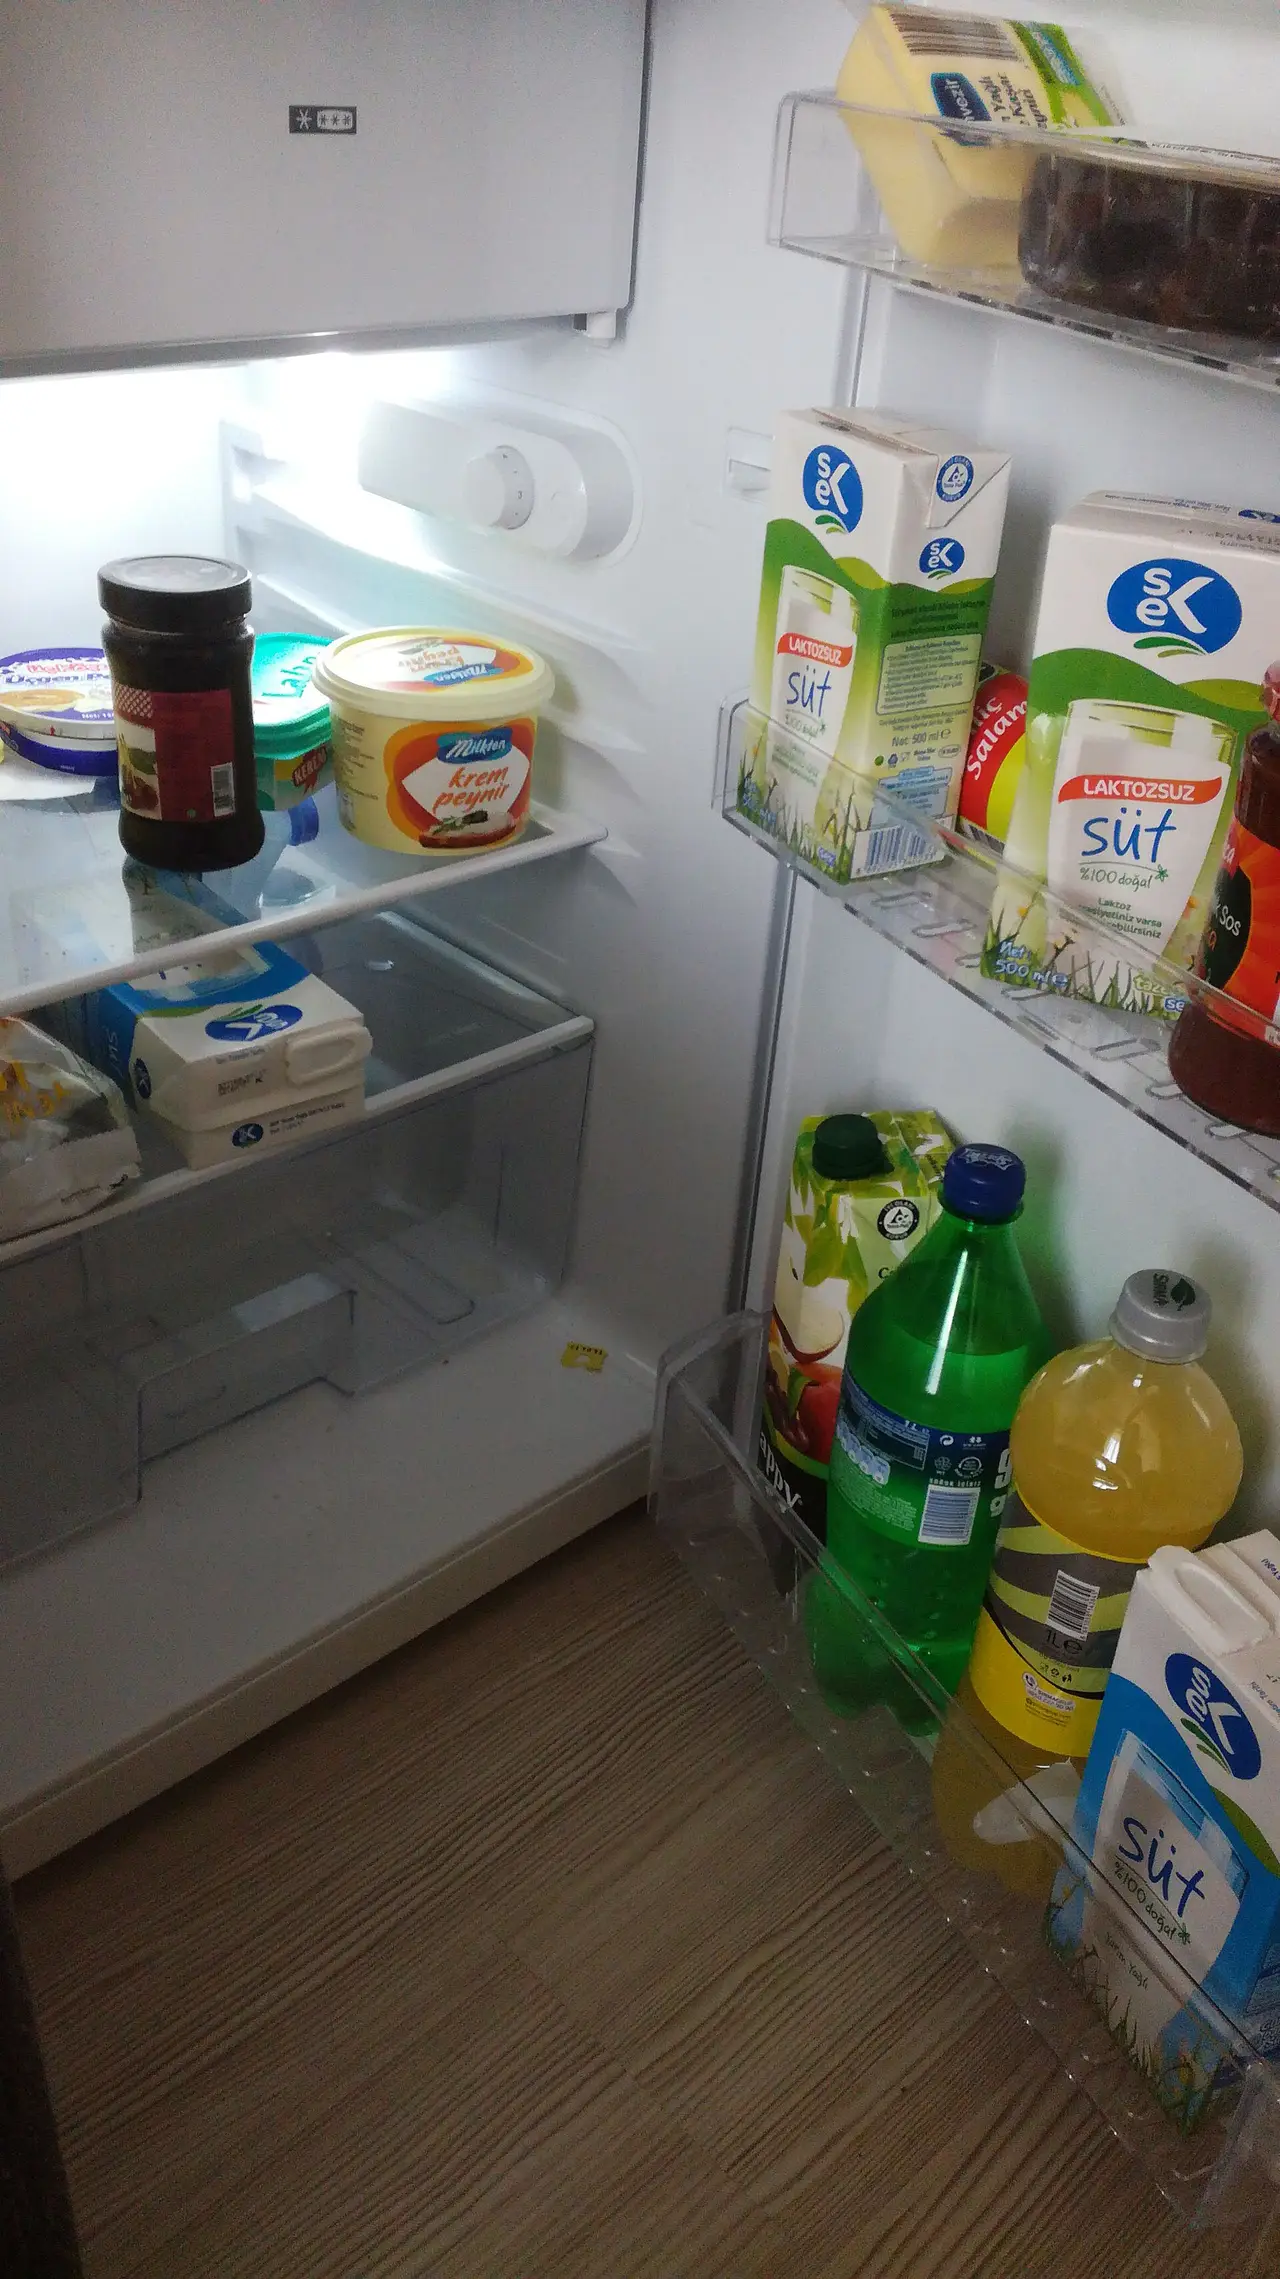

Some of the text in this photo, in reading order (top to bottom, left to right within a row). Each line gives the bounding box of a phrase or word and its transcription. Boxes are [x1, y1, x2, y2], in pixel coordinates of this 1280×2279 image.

[789, 636, 842, 665] LAKTOZSUZ
[786, 665, 832, 717] süt
[446, 738, 506, 758] Milkten
[449, 766, 509, 788] krem
[1083, 778, 1195, 801] LAKTOZSUZ
[432, 783, 511, 816] peynir
[1081, 807, 1177, 863] süt
[1080, 867, 1153, 892] %100 doğal
[1098, 897, 1132, 911] Laktoz
[995, 960, 1029, 977] 500
[1119, 1817, 1205, 1917] süt
[1114, 1861, 1177, 1940] %100 doğal
